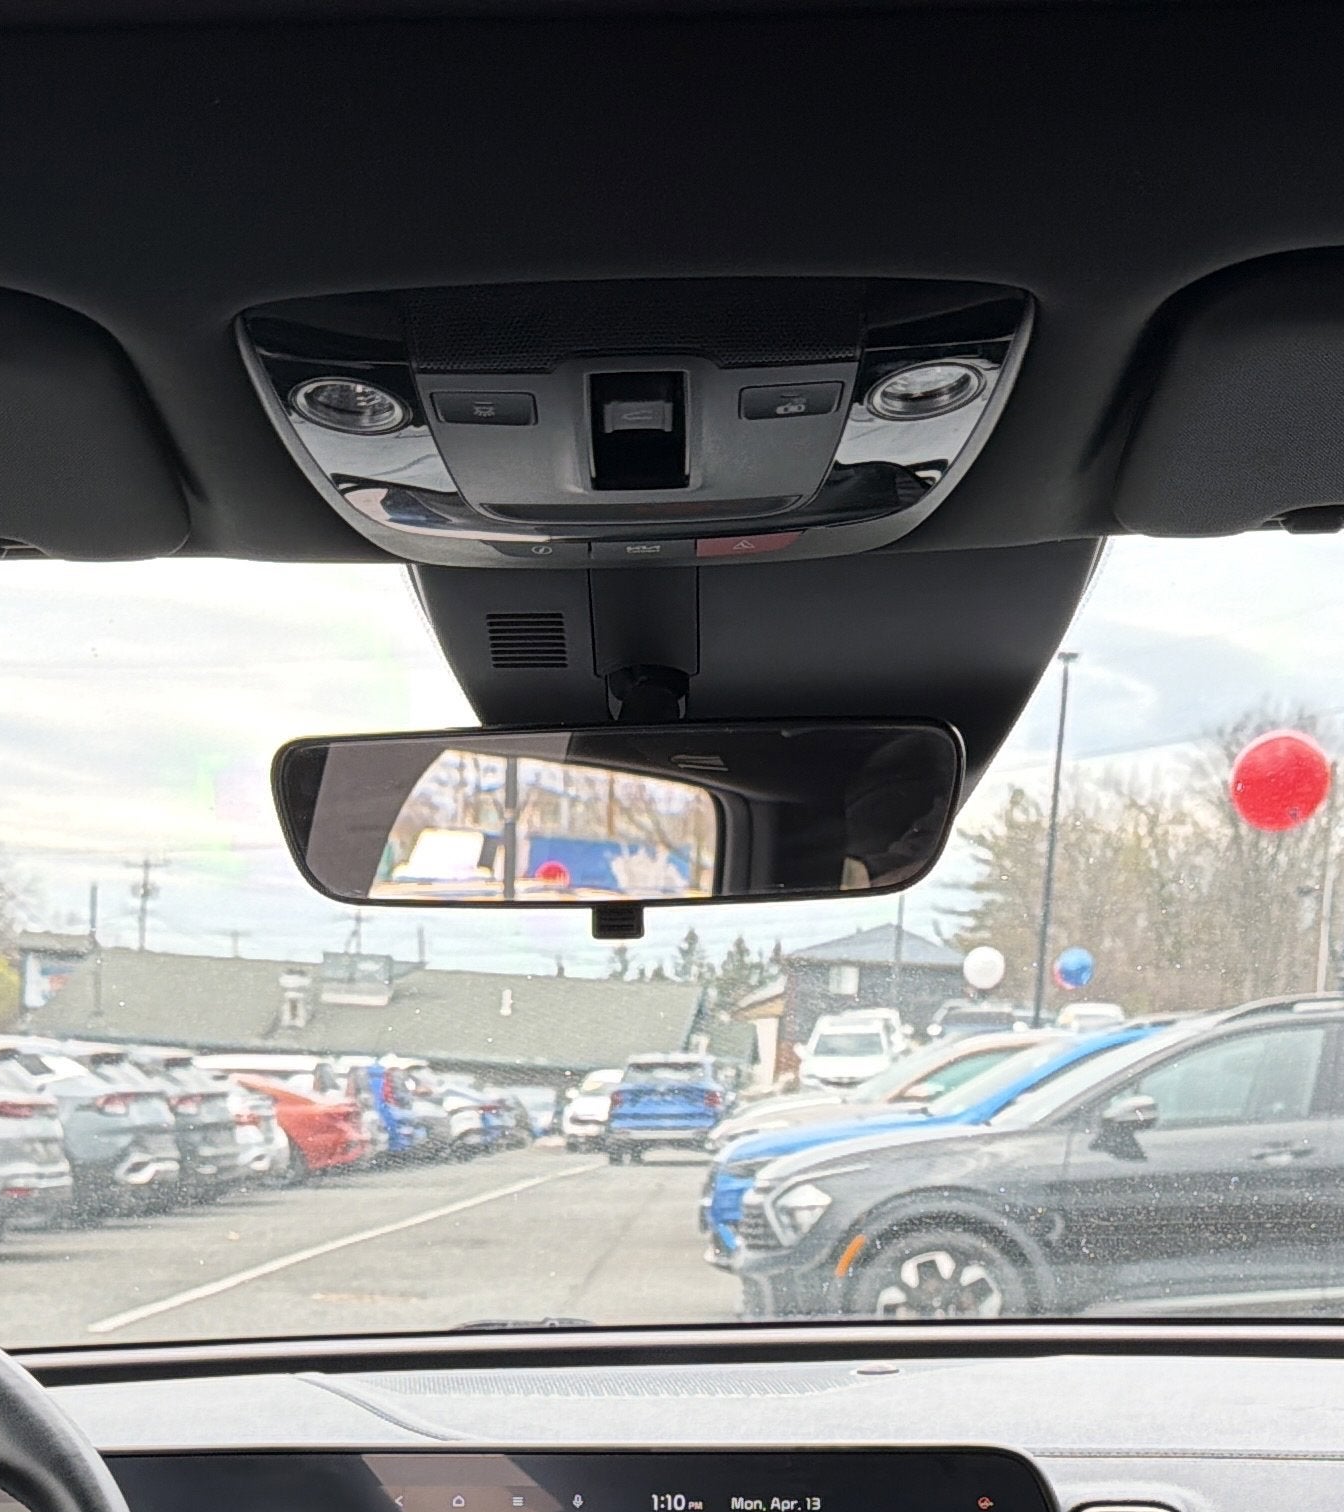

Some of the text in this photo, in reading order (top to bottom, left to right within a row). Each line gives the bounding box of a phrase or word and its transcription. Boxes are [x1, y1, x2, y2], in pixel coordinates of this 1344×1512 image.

[651, 1494, 703, 1511] 1:10 PM
[770, 1497, 802, 1512] Apr.
[805, 1497, 821, 1511] 13
